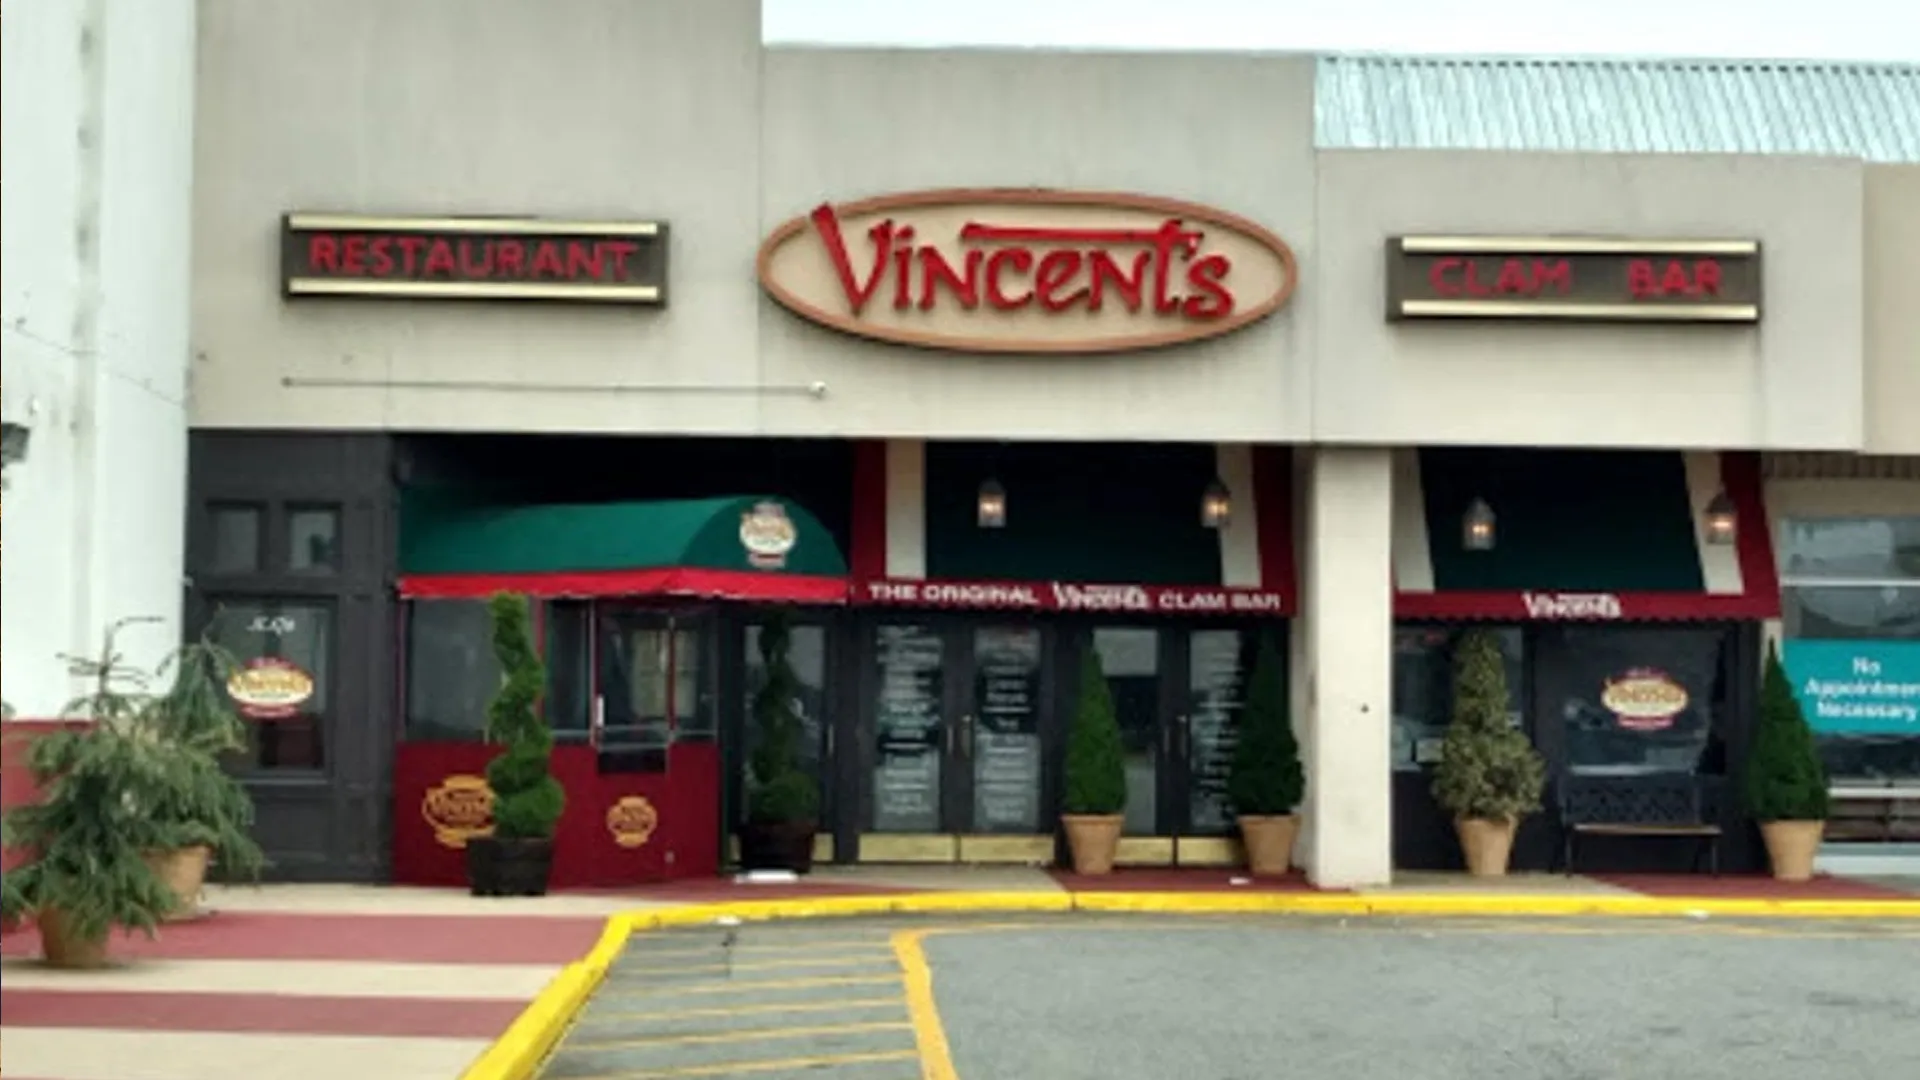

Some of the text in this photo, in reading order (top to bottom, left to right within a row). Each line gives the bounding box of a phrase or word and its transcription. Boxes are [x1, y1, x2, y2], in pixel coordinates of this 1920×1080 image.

[307, 233, 639, 281] RESTAURANT
[1428, 256, 1724, 299] CLAM BAR
[869, 584, 918, 600] THE
[922, 584, 1039, 606] ORIGINAL
[1157, 592, 1226, 610] CLAM
[1231, 593, 1281, 610] BAR
[1852, 656, 1881, 676] No
[1816, 700, 1917, 723] Necessary
